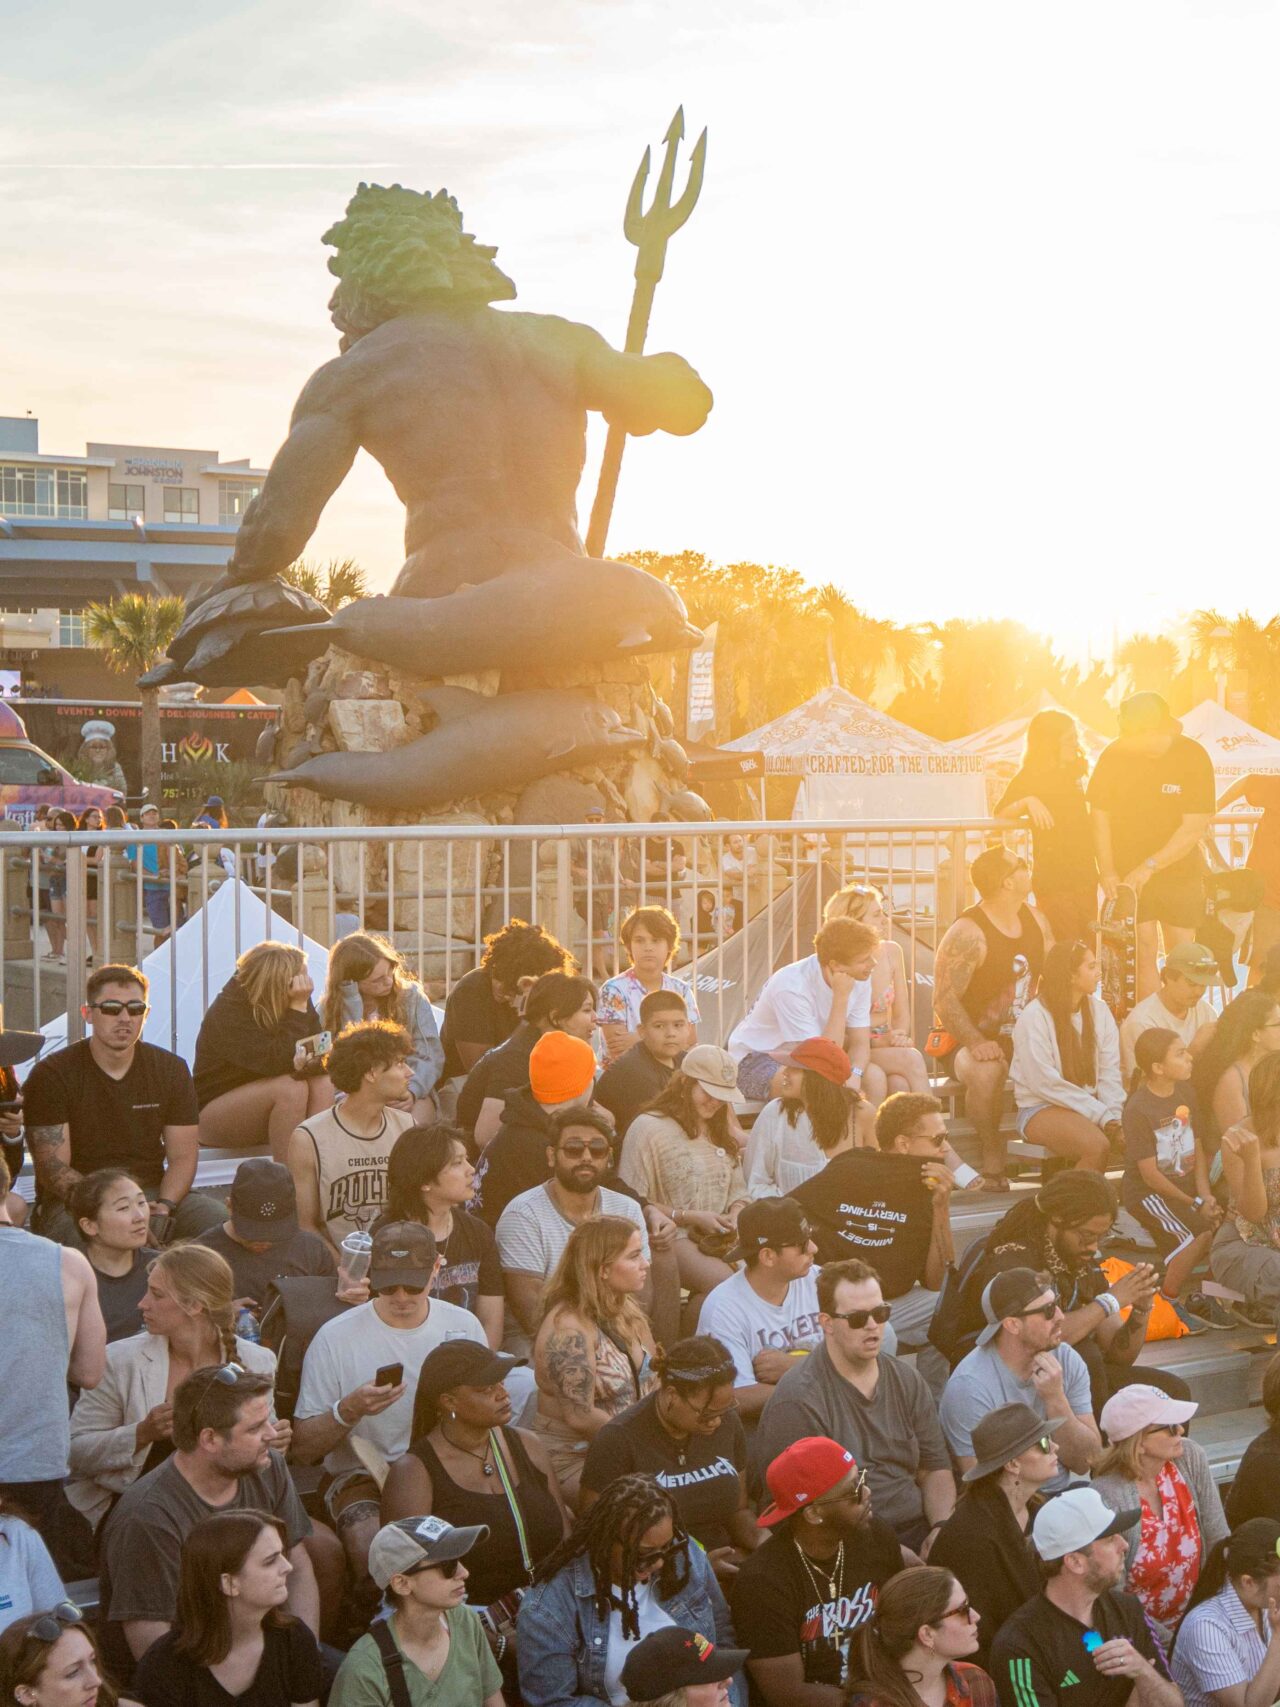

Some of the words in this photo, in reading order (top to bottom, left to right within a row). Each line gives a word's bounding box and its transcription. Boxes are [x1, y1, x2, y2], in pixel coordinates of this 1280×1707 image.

[125, 464, 183, 478] JOHNSTON
[57, 707, 94, 717] EVENTS
[106, 708, 136, 718] DOWN
[167, 710, 236, 719] DELICIOUSNESS
[810, 756, 866, 774] CRAFTED
[872, 756, 894, 774] FOR
[900, 756, 922, 774] THE
[347, 1156, 389, 1167] CHICAGO
[327, 1169, 391, 1221] BULL
[867, 1222, 878, 1231] IS
[837, 1229, 894, 1247] MINDSET
[806, 1603, 820, 1624] THE
[822, 1581, 875, 1637] BOSS
